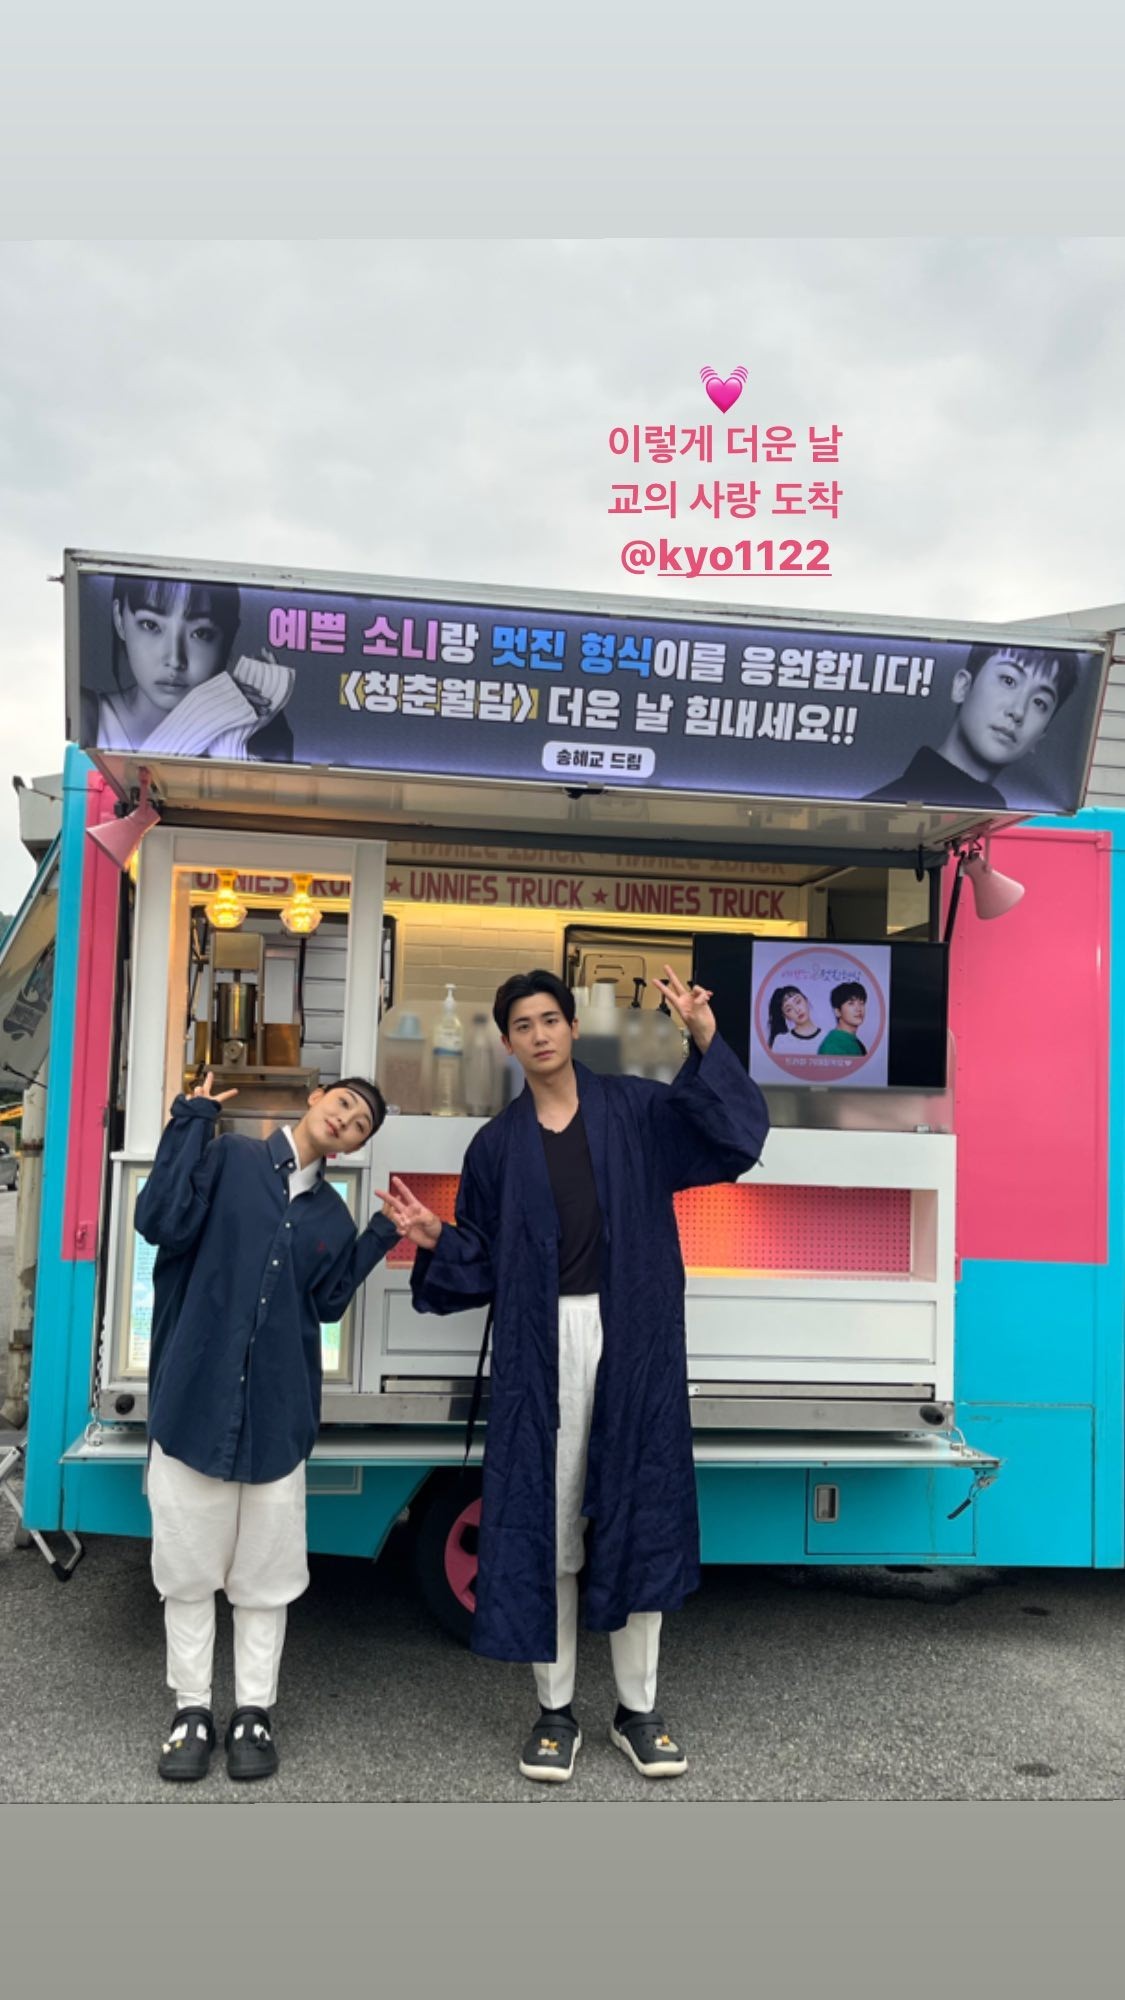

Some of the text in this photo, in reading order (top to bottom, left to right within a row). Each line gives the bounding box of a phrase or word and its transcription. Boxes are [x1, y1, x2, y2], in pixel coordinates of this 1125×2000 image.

[268, 607, 935, 697] 예쁜 소니랑 멋진 형식이를 응원합니다!
[547, 686, 620, 731] 더운
[635, 692, 674, 734] 날
[684, 695, 858, 746] 힘내세요!!
[610, 752, 642, 771] 드림
[409, 870, 499, 906] UNNIES
[507, 875, 585, 909] TRUCK
[614, 882, 701, 916] UNNIES
[708, 887, 786, 920] TRUCK
